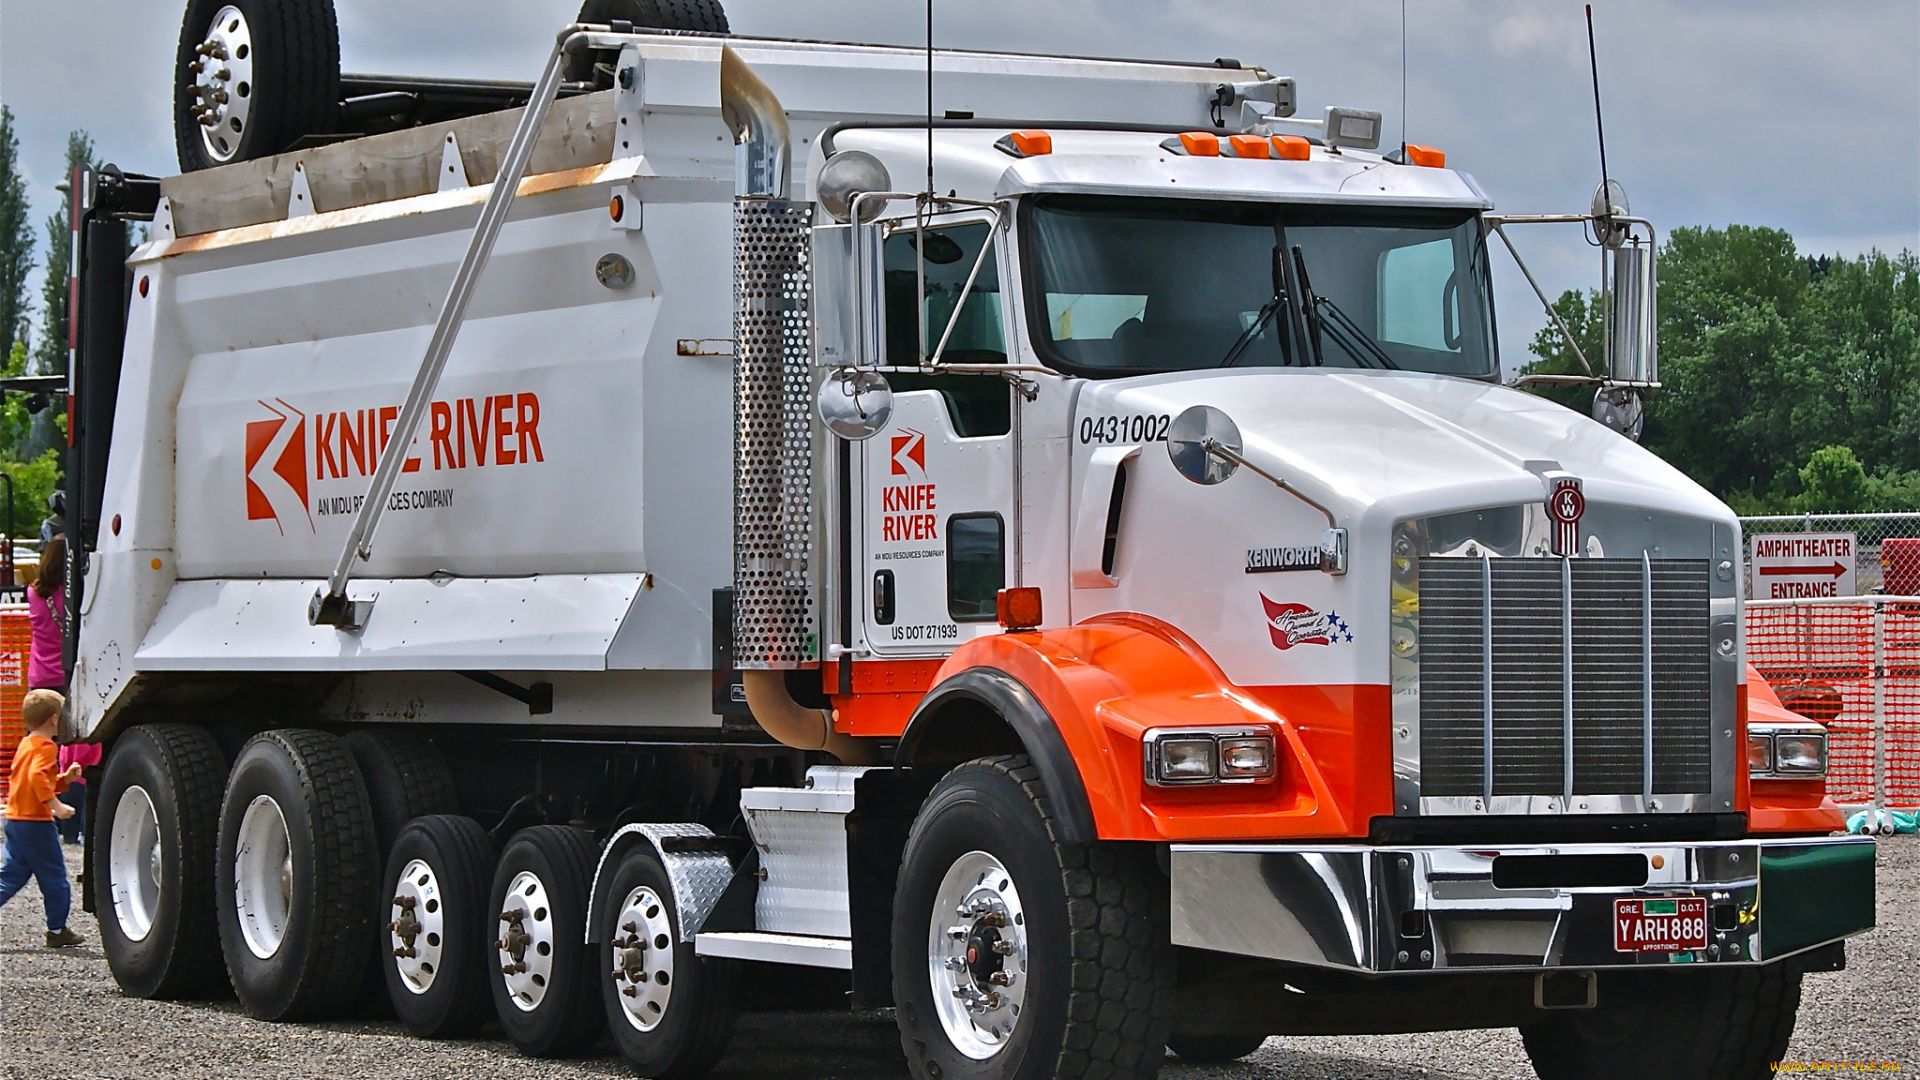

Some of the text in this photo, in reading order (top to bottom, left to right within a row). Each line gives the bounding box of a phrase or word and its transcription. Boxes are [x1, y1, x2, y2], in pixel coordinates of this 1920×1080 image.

[430, 392, 544, 470] RIVER
[1080, 414, 1170, 444] 0431002
[318, 498, 330, 516] AN
[331, 496, 352, 515] MDU
[411, 488, 454, 510] COMPANY
[883, 484, 936, 512] KNIFE
[883, 514, 937, 541] RIVER
[882, 552, 892, 560] MDU
[893, 550, 921, 559] RESOURCES
[922, 549, 945, 558] COMPANY
[1246, 545, 1321, 568] KENWORTH
[1756, 538, 1850, 558] AMPHITHEATER
[65, 538, 75, 598] Strong
[1771, 581, 1837, 599] ENTRANCE
[1275, 610, 1320, 625] American
[1285, 618, 1317, 633] Owned
[892, 624, 958, 640] US DOT 271939
[1287, 627, 1331, 644] Operated
[1620, 905, 1640, 914] ORE.
[1681, 904, 1703, 912] D.O.T.
